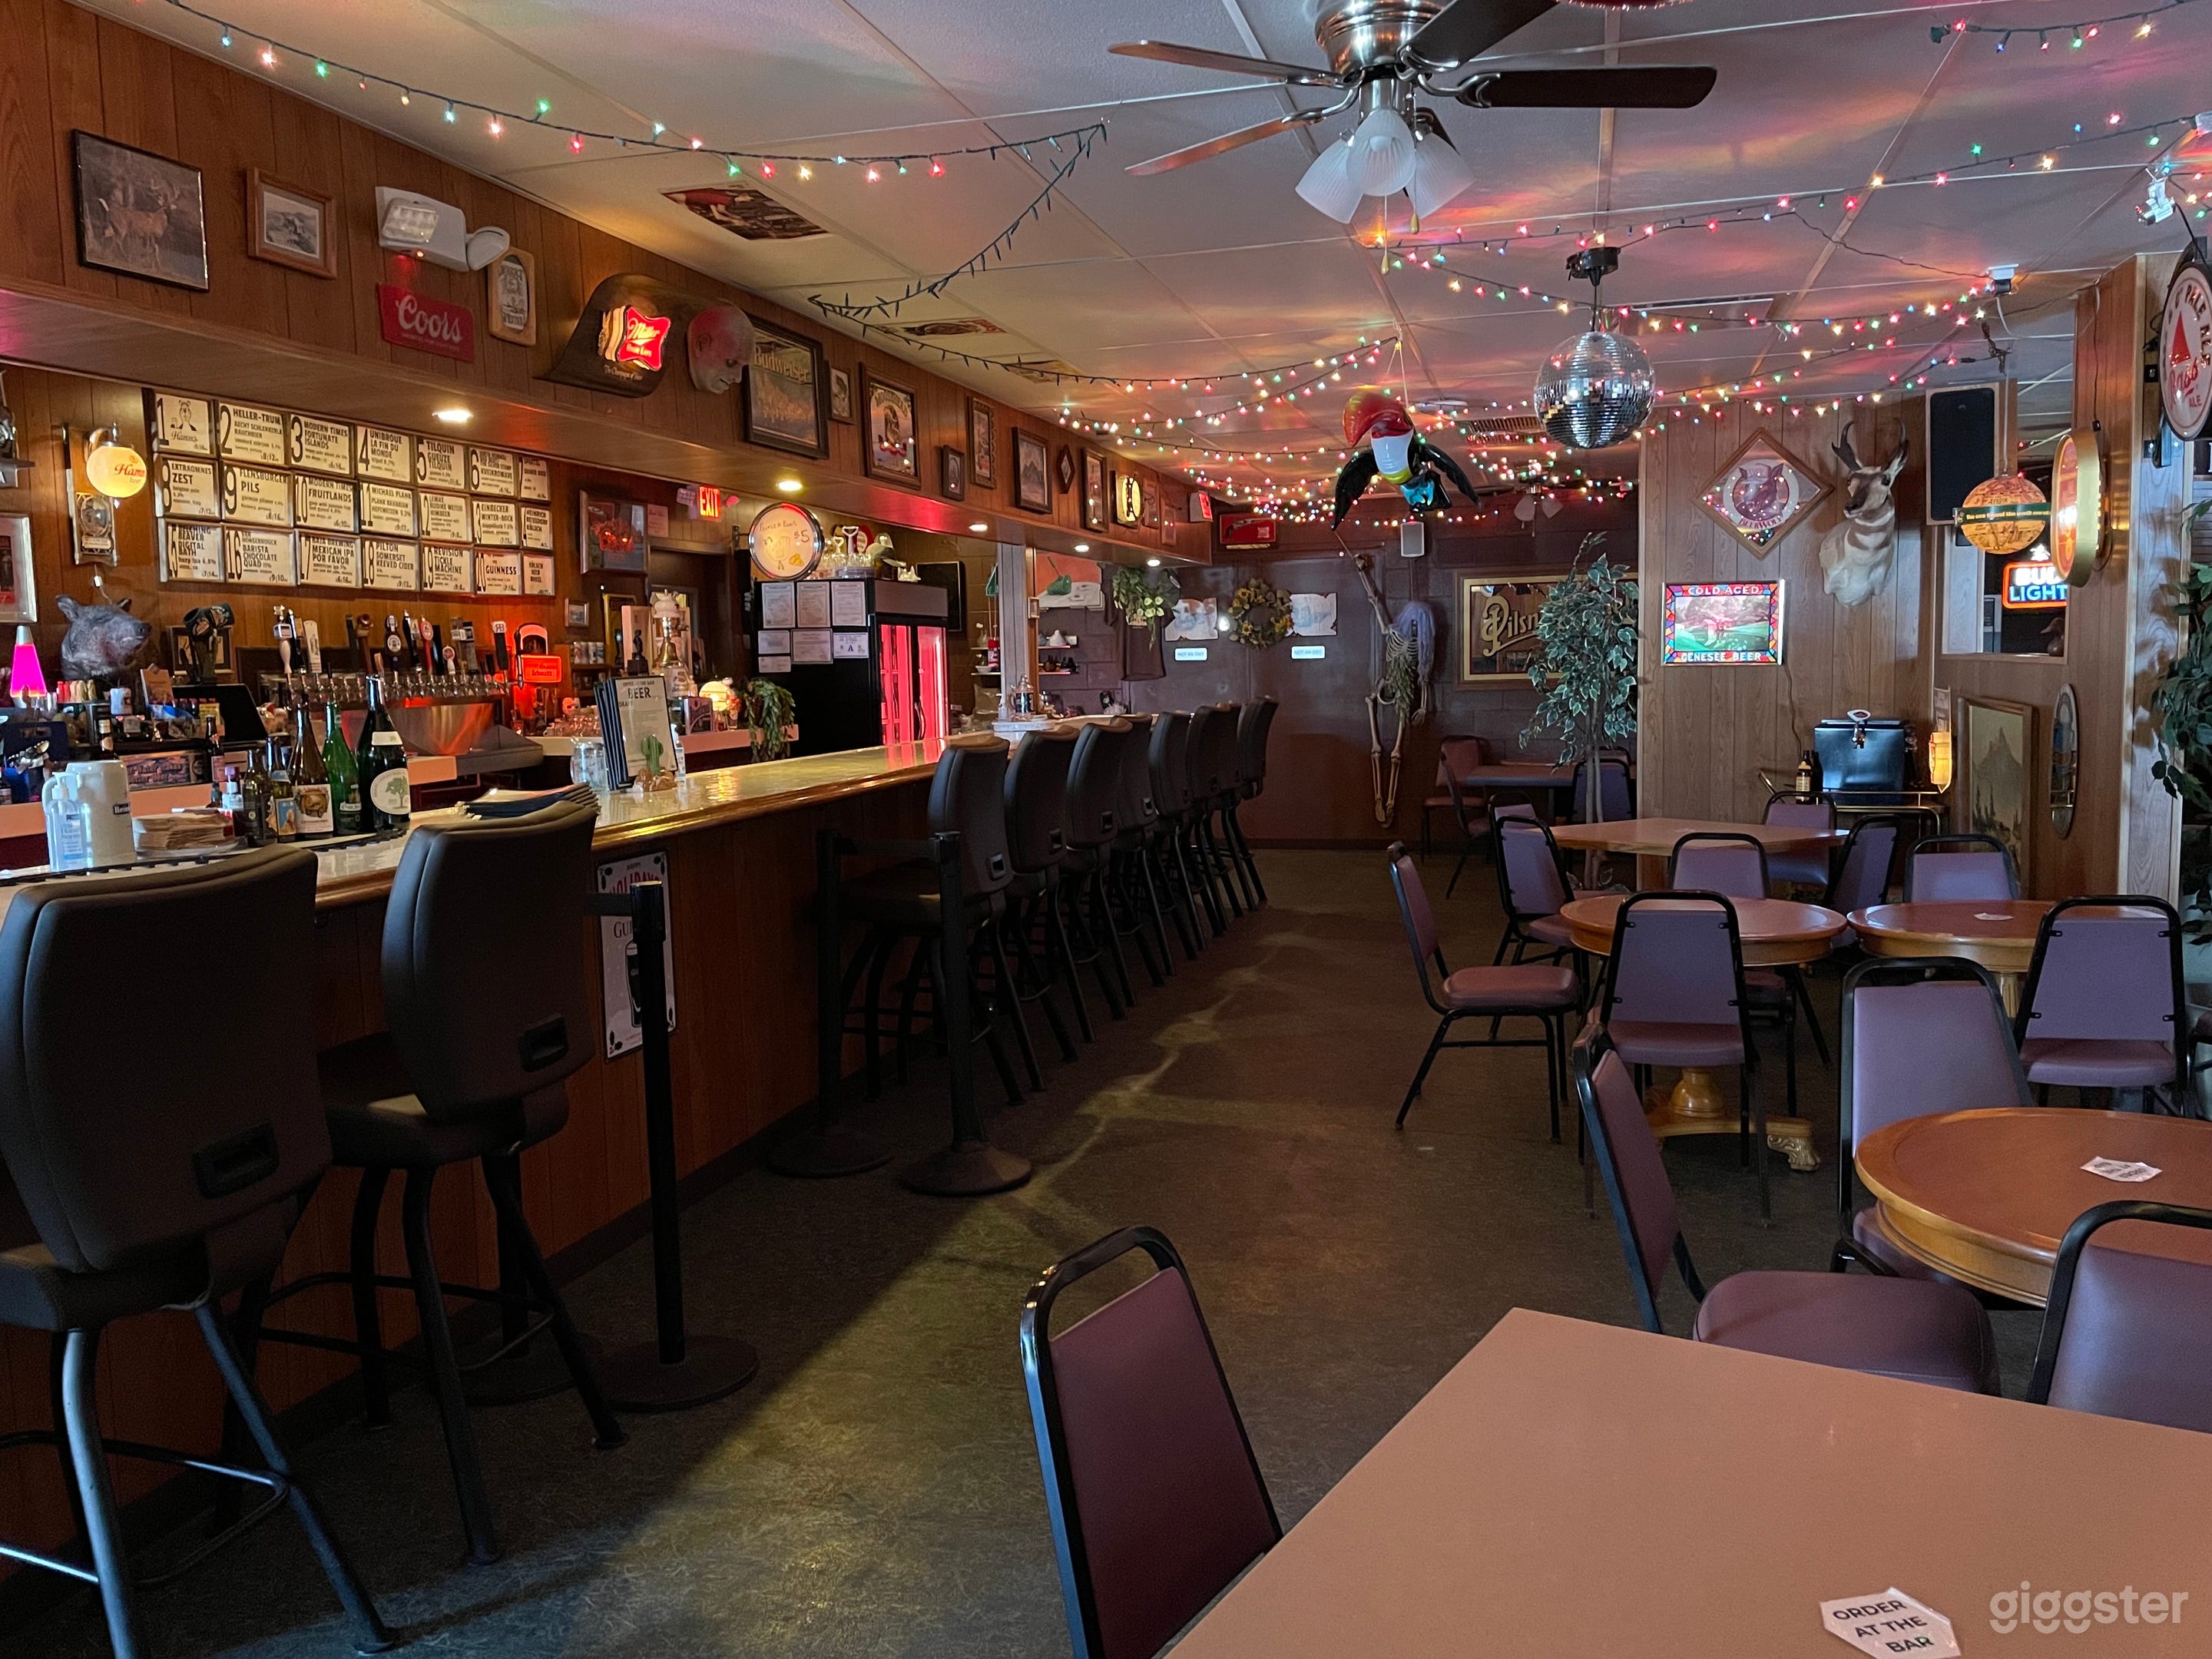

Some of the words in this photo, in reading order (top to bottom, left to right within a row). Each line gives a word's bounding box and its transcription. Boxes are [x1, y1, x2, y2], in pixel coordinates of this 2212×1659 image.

[2185, 284, 2207, 321] PALE
[395, 295, 463, 343] Coors
[628, 318, 660, 339] Miller
[754, 346, 810, 383] Budweiser
[2189, 395, 2202, 408] ALE
[157, 398, 170, 445] 1
[233, 408, 281, 426] HELLER-TRUM
[220, 405, 232, 454] 2
[304, 421, 328, 433] MODERN
[330, 426, 348, 437] TIMES
[292, 416, 303, 463] 3
[305, 429, 338, 444] FORTUNATE
[369, 430, 402, 444] UNIBROUE
[305, 438, 329, 449] ISLANDS
[359, 429, 369, 471] 4
[370, 439, 378, 448] LA
[379, 441, 389, 450] FIN
[390, 442, 399, 452] DU
[426, 441, 455, 454] TILQUIN
[371, 447, 392, 459] MONDE
[417, 438, 426, 481] 5
[427, 452, 450, 462] GUEUZE
[429, 460, 452, 472] TILQUIN
[471, 449, 479, 490] 6
[172, 472, 193, 485] ZEST
[239, 467, 287, 484] FLENSBURGER
[224, 465, 237, 515] 9
[241, 481, 260, 493] PILS
[371, 487, 395, 497] MICHAEL
[309, 488, 352, 503] FRUITLANDS
[699, 486, 719, 518] EXIT
[481, 503, 508, 513] EINBECKER
[481, 514, 514, 522] WINTER-BOCK
[178, 529, 204, 541] BEAVER
[178, 540, 205, 550] DIGITAL
[178, 547, 197, 556] BATH
[243, 545, 269, 554] BARISTA
[313, 545, 342, 556] MEXICAN
[343, 548, 355, 558] IPA
[376, 542, 399, 552] PILTON
[227, 530, 242, 581] 16
[243, 552, 277, 562] CHOCOLATE
[376, 551, 406, 561] SOMERSET
[433, 546, 463, 558] REVISION
[243, 559, 262, 568] QUAD
[313, 553, 326, 563] POR
[328, 555, 349, 565] FAVOR
[363, 540, 375, 585] 18
[376, 560, 398, 569] KEEVED
[399, 561, 414, 570] CIDER
[434, 555, 452, 566] TICKLE
[435, 565, 462, 575] MACHINE
[485, 566, 517, 575] GUINNESS
[2014, 566, 2061, 586] BUD
[1688, 586, 1720, 595] COLD
[1724, 585, 1760, 594] AGED
[2008, 584, 2068, 601] LIGHT
[1482, 594, 1539, 657] Pilsn
[1681, 653, 1727, 661] GENESEE
[1733, 652, 1762, 661] BEER
[628, 687, 651, 699] BEER
[1832, 1600, 1907, 1620] ORDER
[1854, 1624, 1881, 1637] AT
[1880, 1615, 1928, 1632] THE
[1885, 1636, 1935, 1652] BAR
